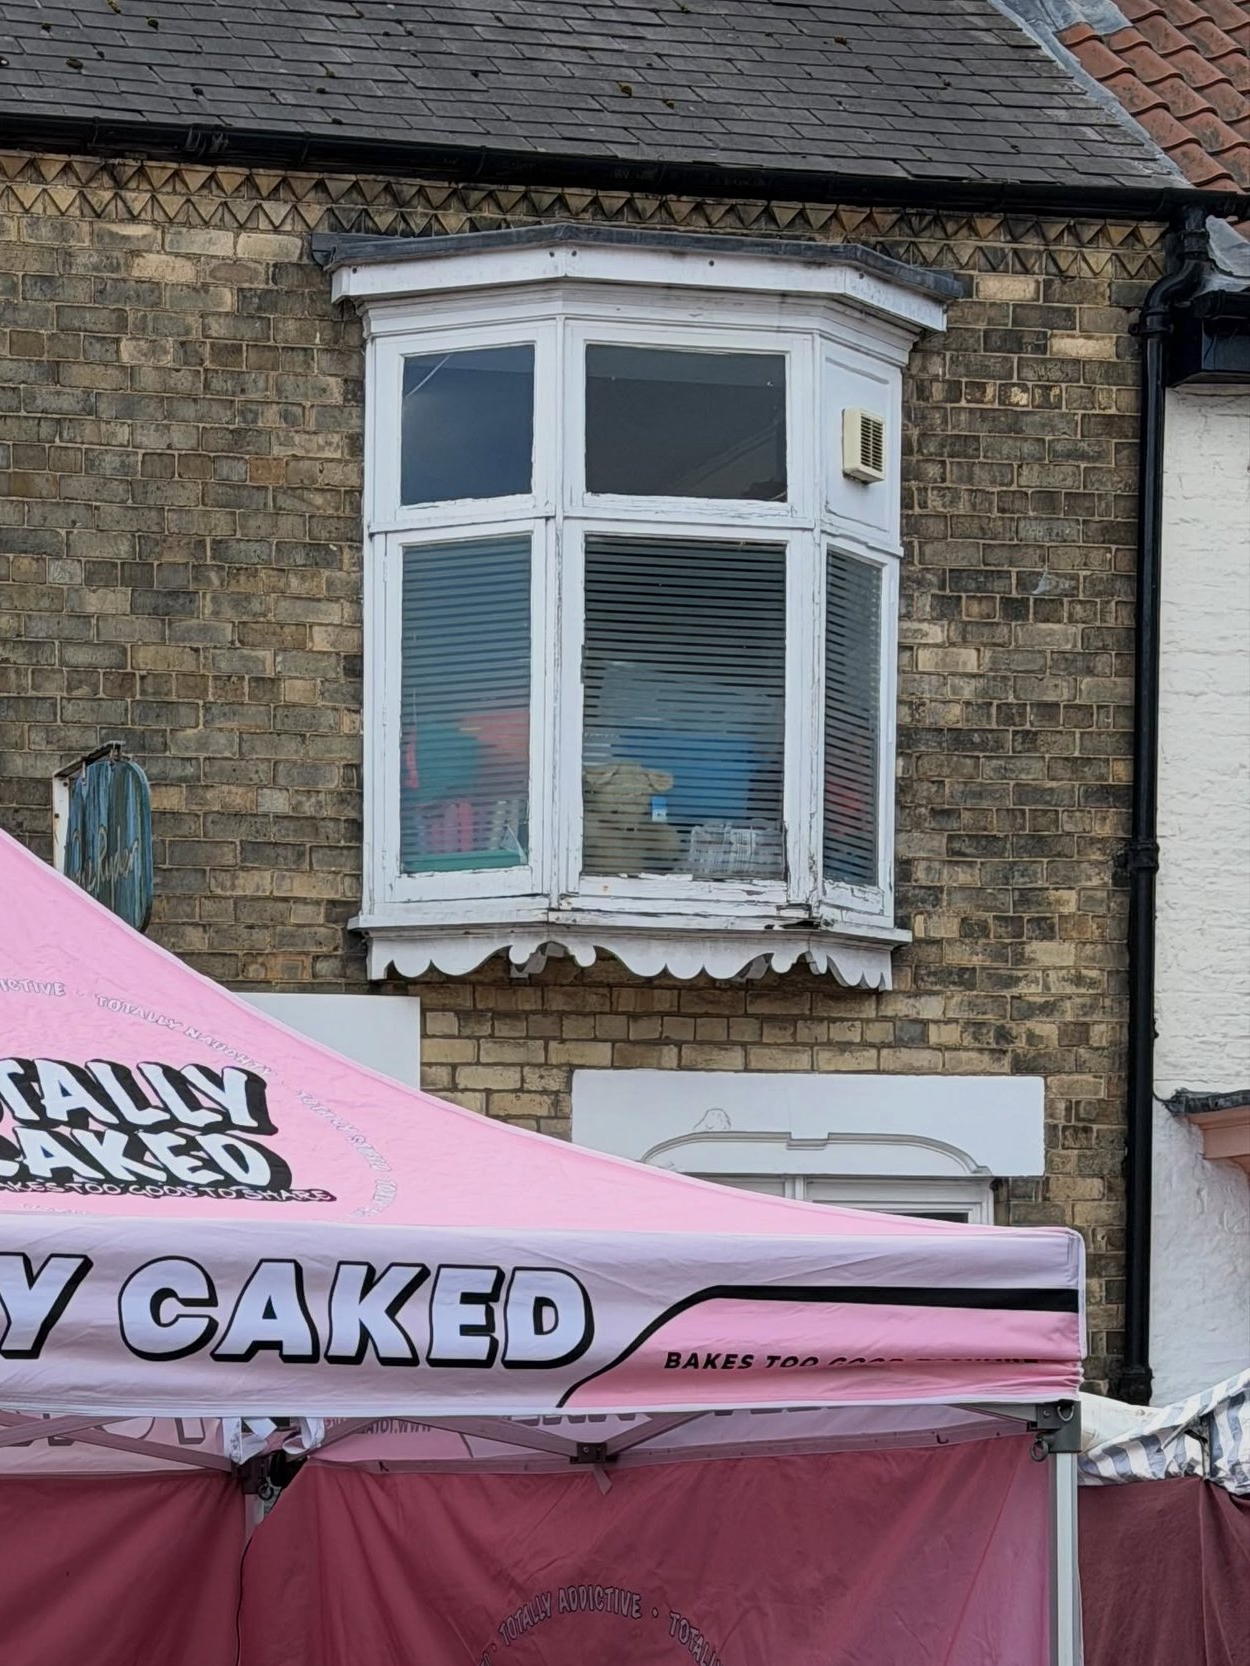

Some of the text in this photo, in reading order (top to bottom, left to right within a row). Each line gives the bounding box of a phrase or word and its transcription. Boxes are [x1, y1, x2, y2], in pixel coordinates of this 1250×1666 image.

[95, 993, 184, 1031] TOTALLY
[64, 1182, 121, 1196] TOO
[128, 1184, 197, 1199] GOOD
[202, 1186, 236, 1200] TO
[241, 1188, 333, 1202] SHARE
[117, 1256, 595, 1368] CAKED
[663, 1351, 754, 1370] BAKES
[498, 1584, 642, 1648] TOTALLY ADDICTIVE
